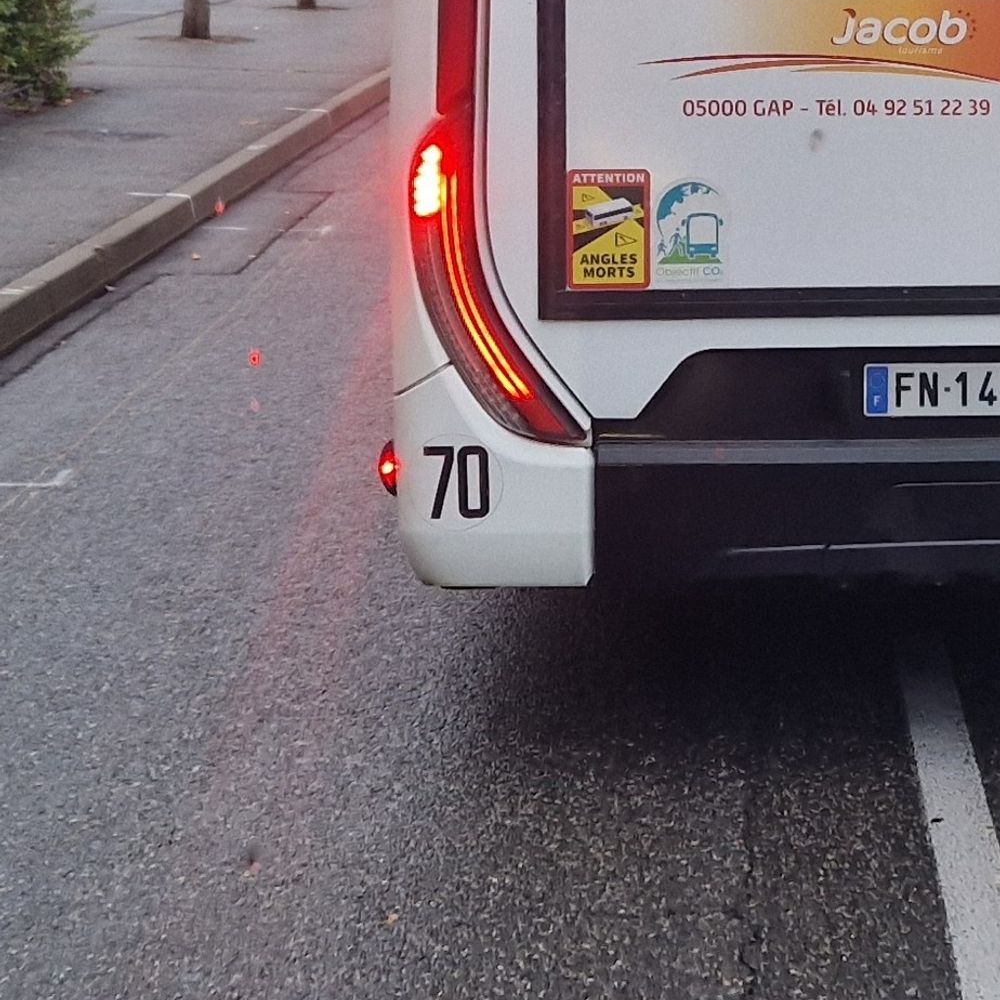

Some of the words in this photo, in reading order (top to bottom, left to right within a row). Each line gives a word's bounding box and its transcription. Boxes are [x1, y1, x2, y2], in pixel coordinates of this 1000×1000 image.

[682, 99, 747, 117] 05000
[753, 99, 793, 117] GAP
[816, 97, 847, 117] Tél.
[853, 99, 878, 117] 04
[884, 98, 906, 117] 92
[913, 98, 934, 116] 51
[940, 98, 962, 116] 22
[968, 98, 991, 116] 39
[572, 173, 645, 184] ATTENTION
[580, 253, 638, 265] ANGLES
[583, 266, 635, 278] MORTS
[873, 395, 880, 406] F
[423, 445, 490, 519] 70
